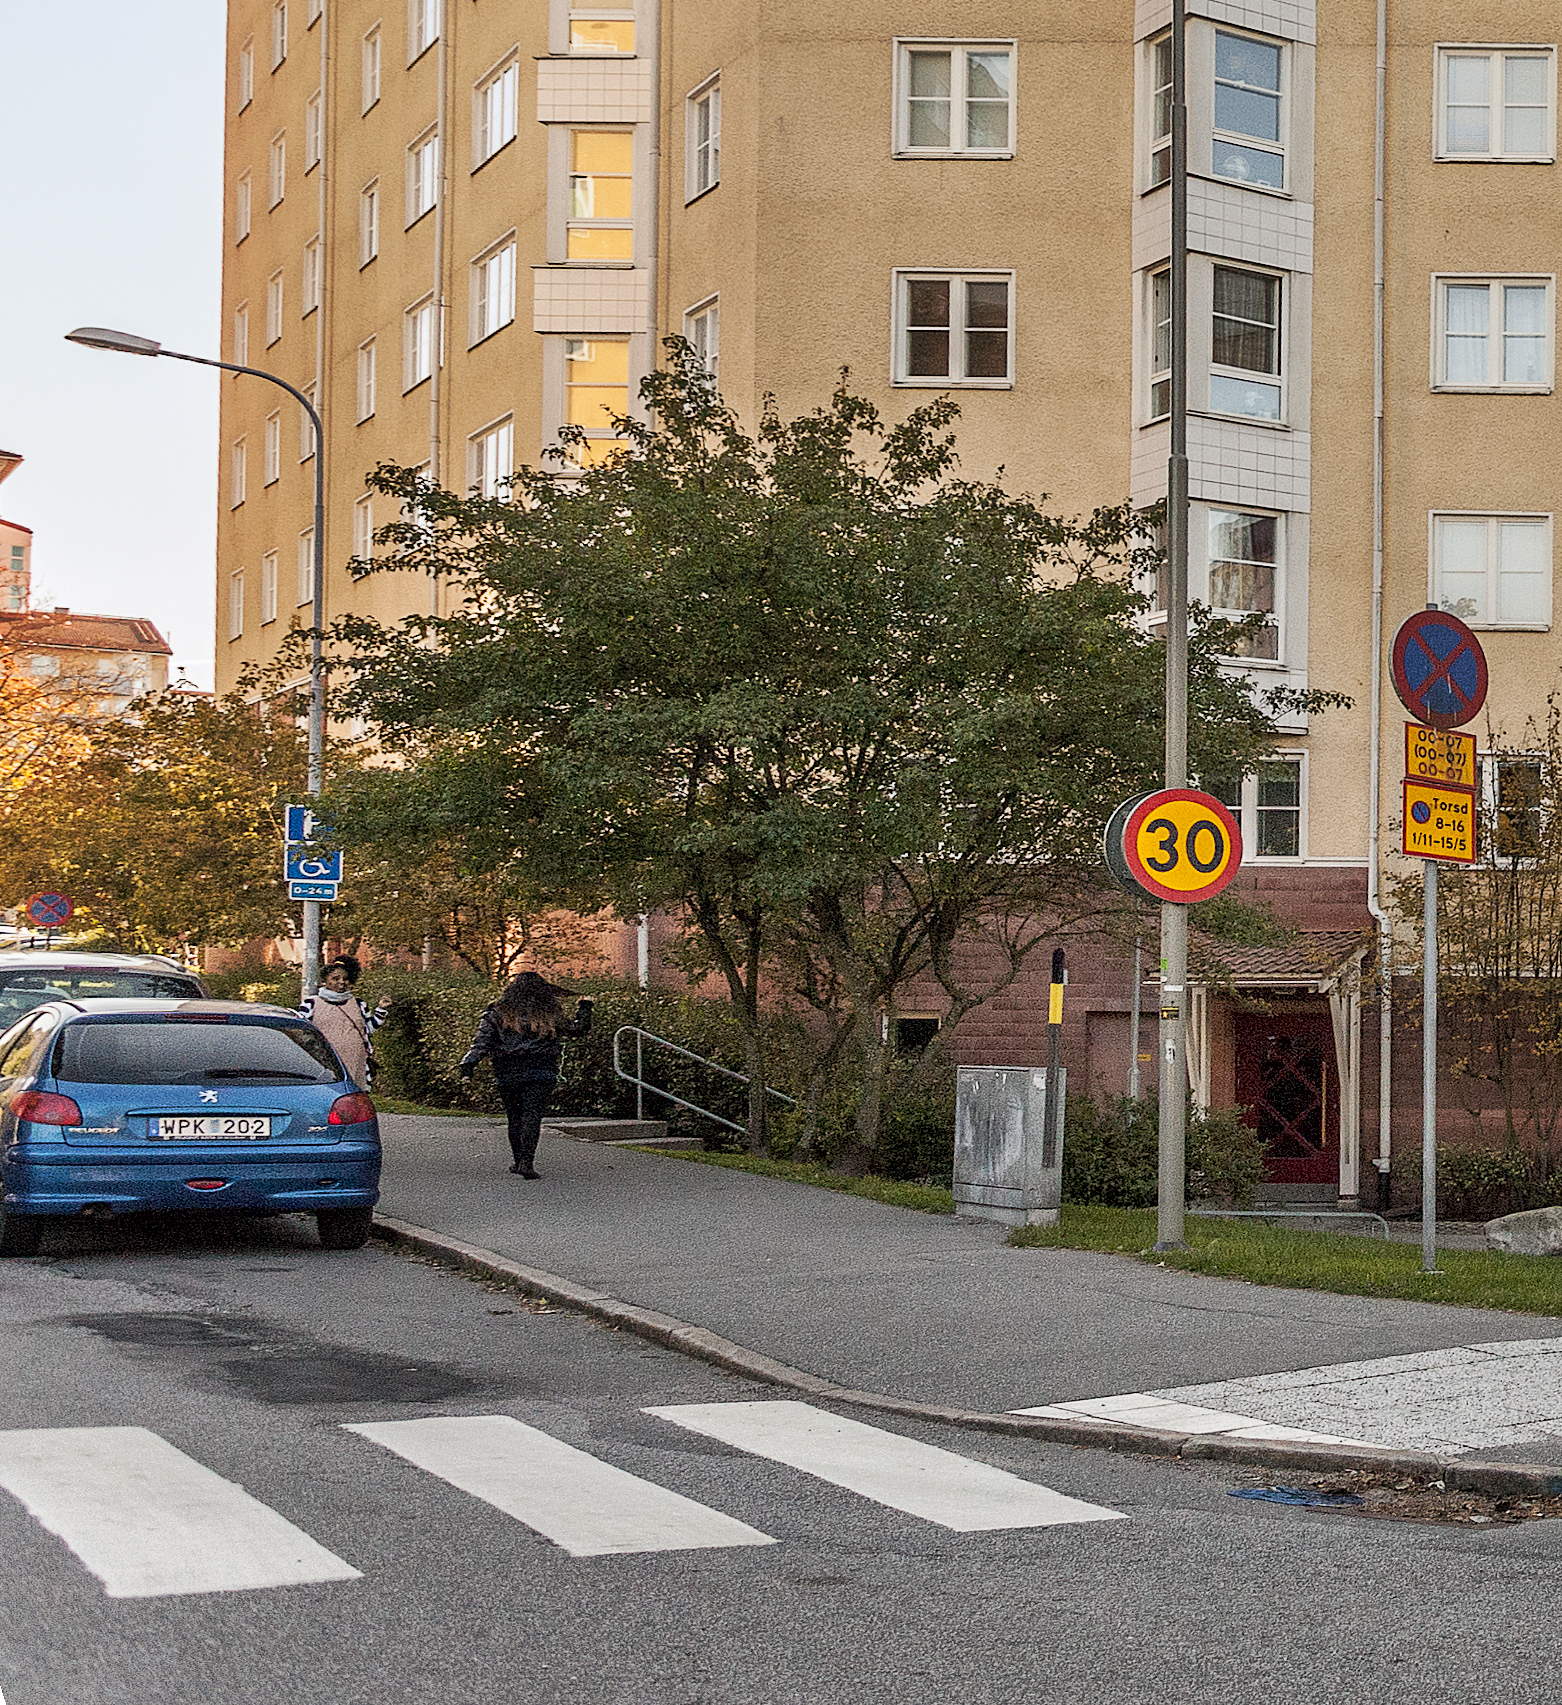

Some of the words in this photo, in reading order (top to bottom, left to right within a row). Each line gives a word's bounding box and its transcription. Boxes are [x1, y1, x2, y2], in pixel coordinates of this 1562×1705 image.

[1418, 730, 1462, 749] 00-07
[1414, 744, 1467, 766] (00-07)
[1418, 761, 1463, 781] 00-07
[1433, 797, 1468, 814] Torsd
[1435, 817, 1465, 833] 8-16
[1145, 818, 1224, 873] 30
[1412, 832, 1467, 851] 1/11-15/5
[293, 886, 323, 895] 0-24
[163, 1119, 205, 1134] WPK
[224, 1119, 265, 1134] 202
